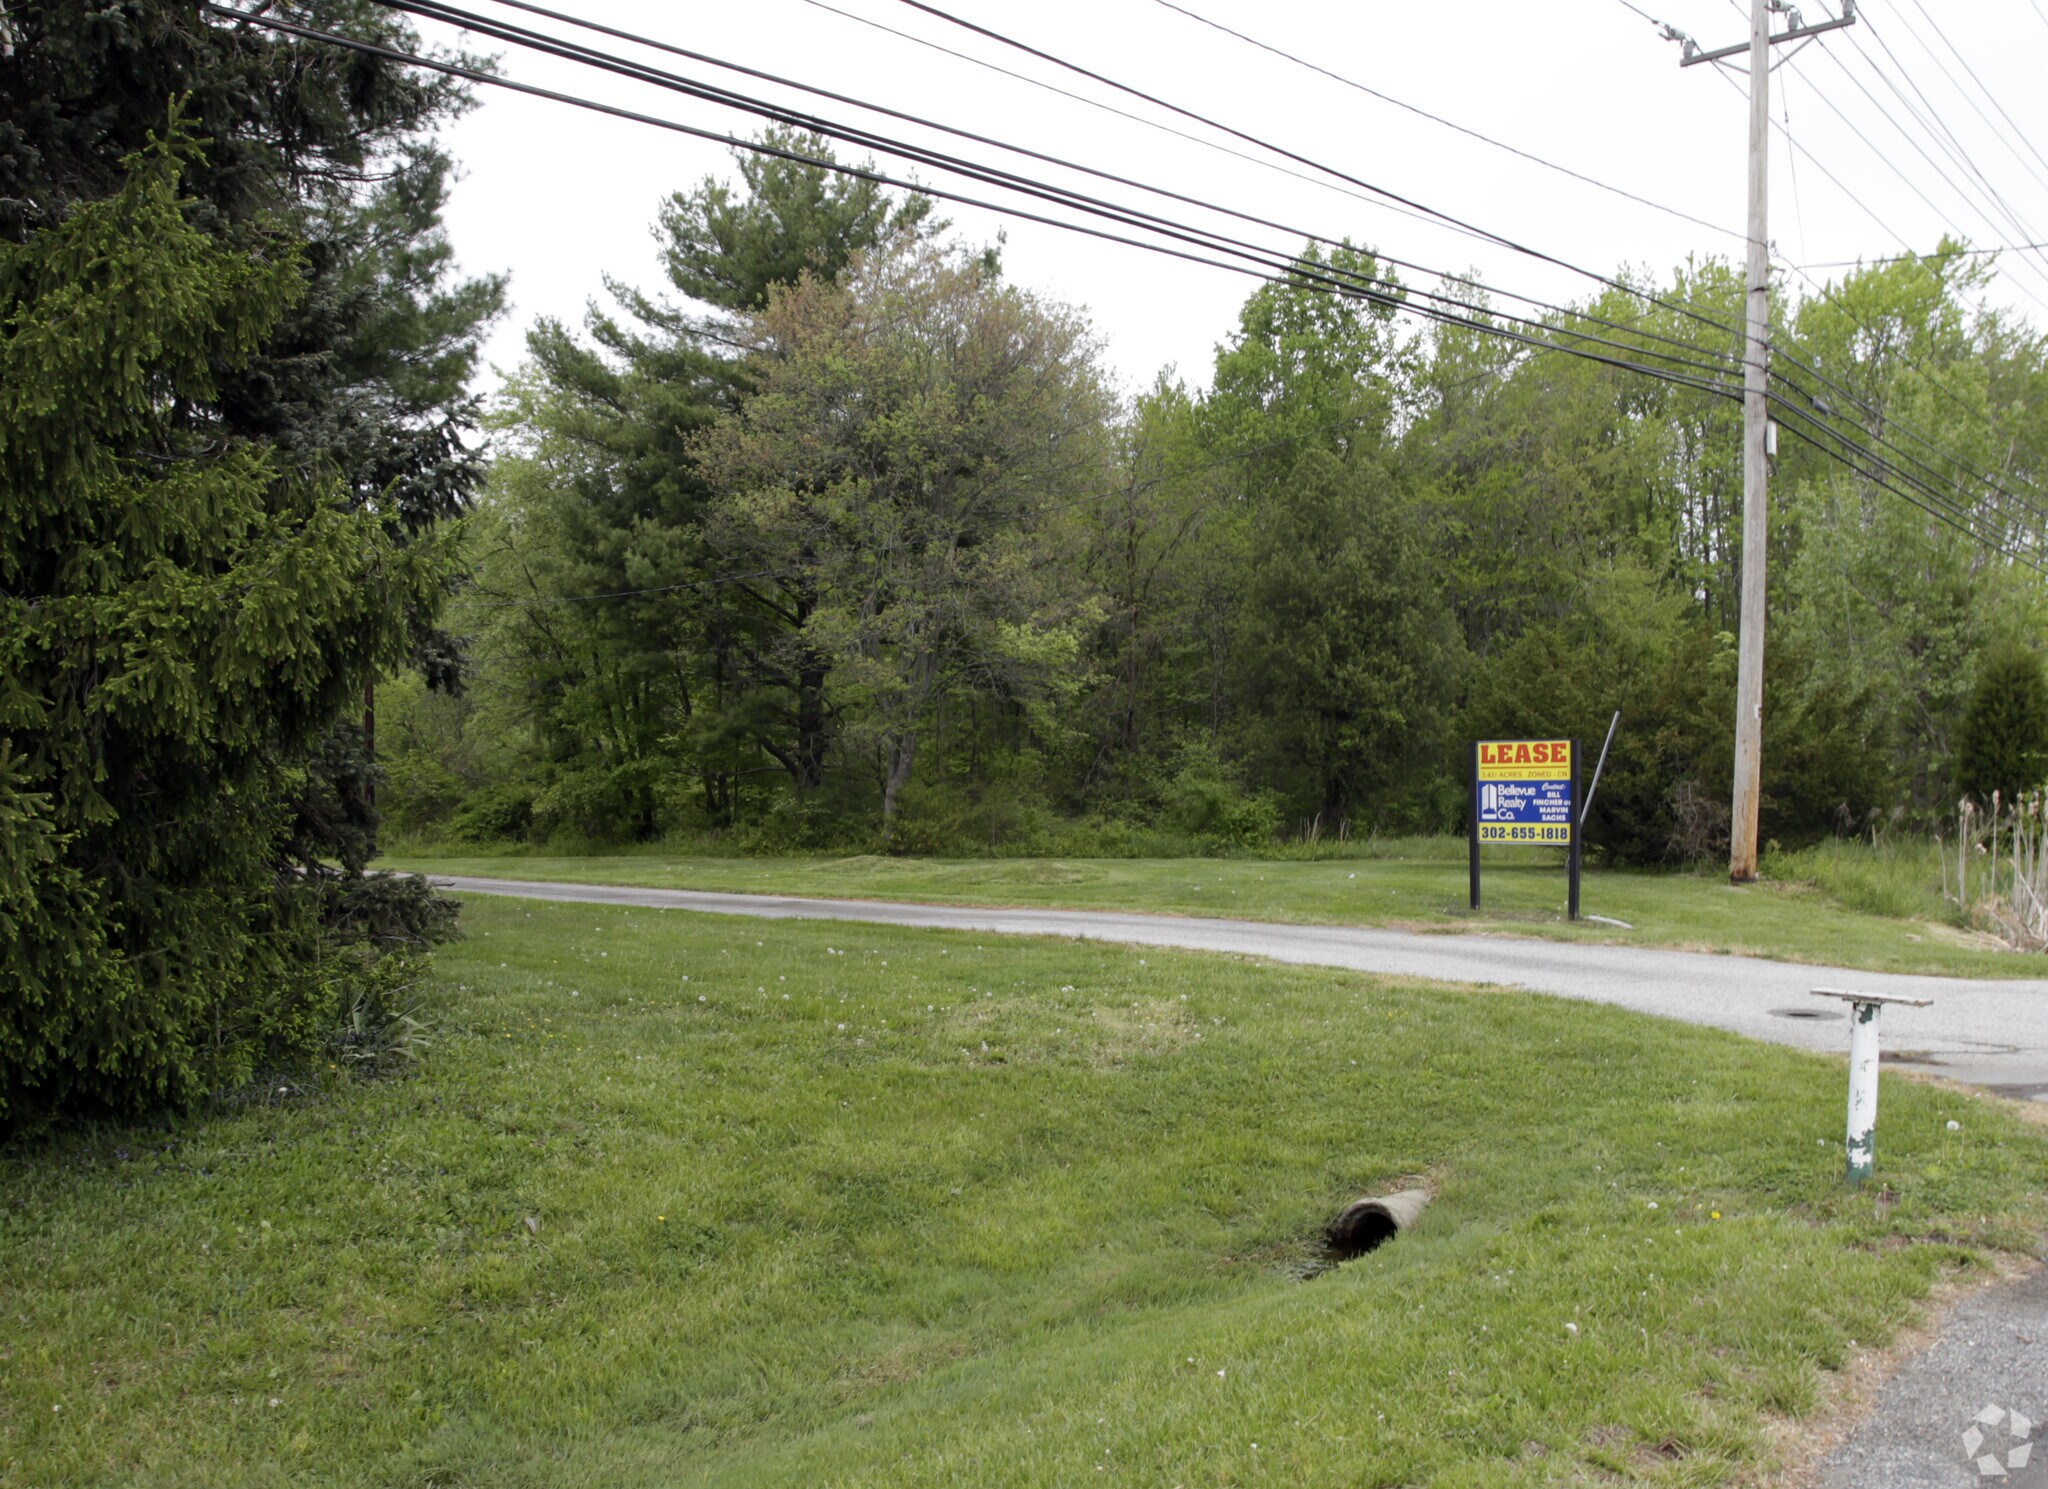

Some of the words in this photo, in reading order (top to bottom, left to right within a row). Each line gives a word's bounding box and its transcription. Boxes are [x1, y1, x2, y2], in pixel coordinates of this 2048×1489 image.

[1481, 743, 1567, 764] LEASE
[1498, 784, 1536, 796] Bellevue
[1498, 797, 1527, 811] Realty
[1539, 806, 1569, 814] MARVIN
[1497, 808, 1515, 820] Co.
[1481, 827, 1568, 840] 302-655-1818
